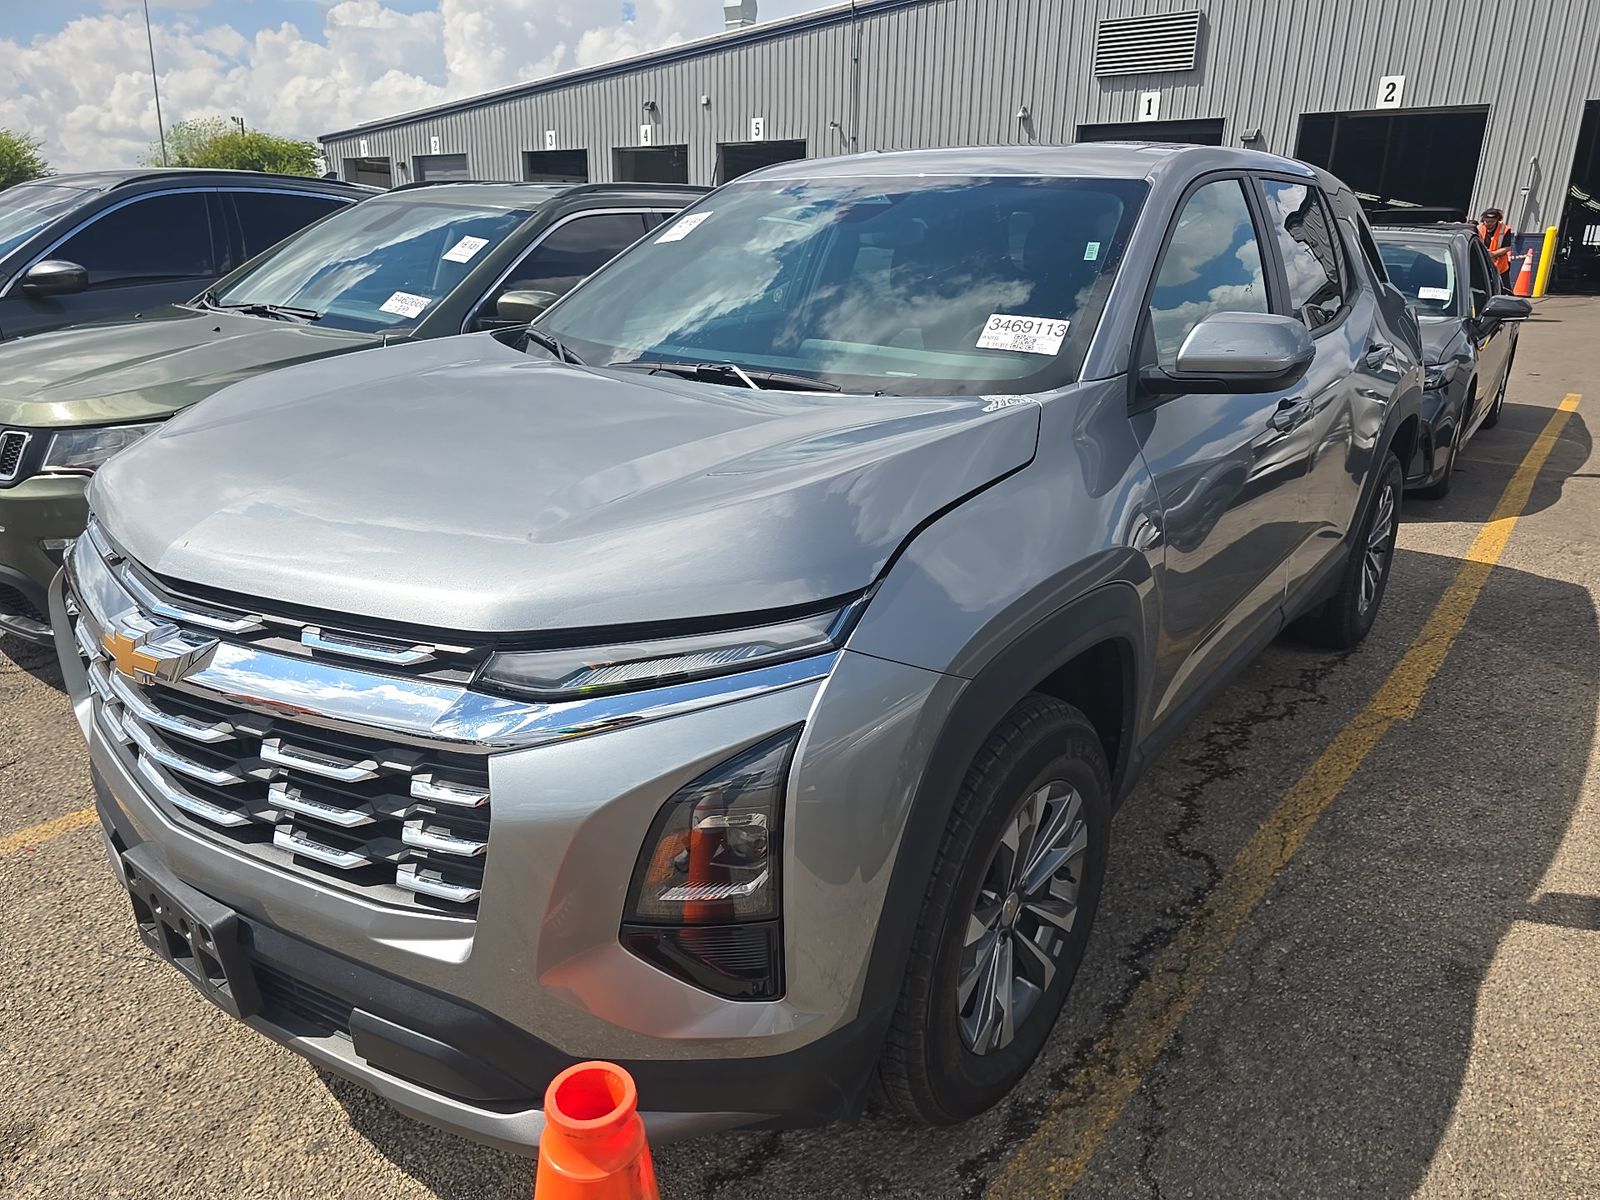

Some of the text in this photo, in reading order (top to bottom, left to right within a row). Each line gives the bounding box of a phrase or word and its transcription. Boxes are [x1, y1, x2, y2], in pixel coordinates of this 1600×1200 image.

[1383, 82, 1397, 103] 2
[1145, 97, 1152, 116] 1
[643, 128, 649, 142] 4
[754, 121, 761, 137] 5
[548, 133, 554, 147] 3
[988, 317, 1067, 337] 3469113
